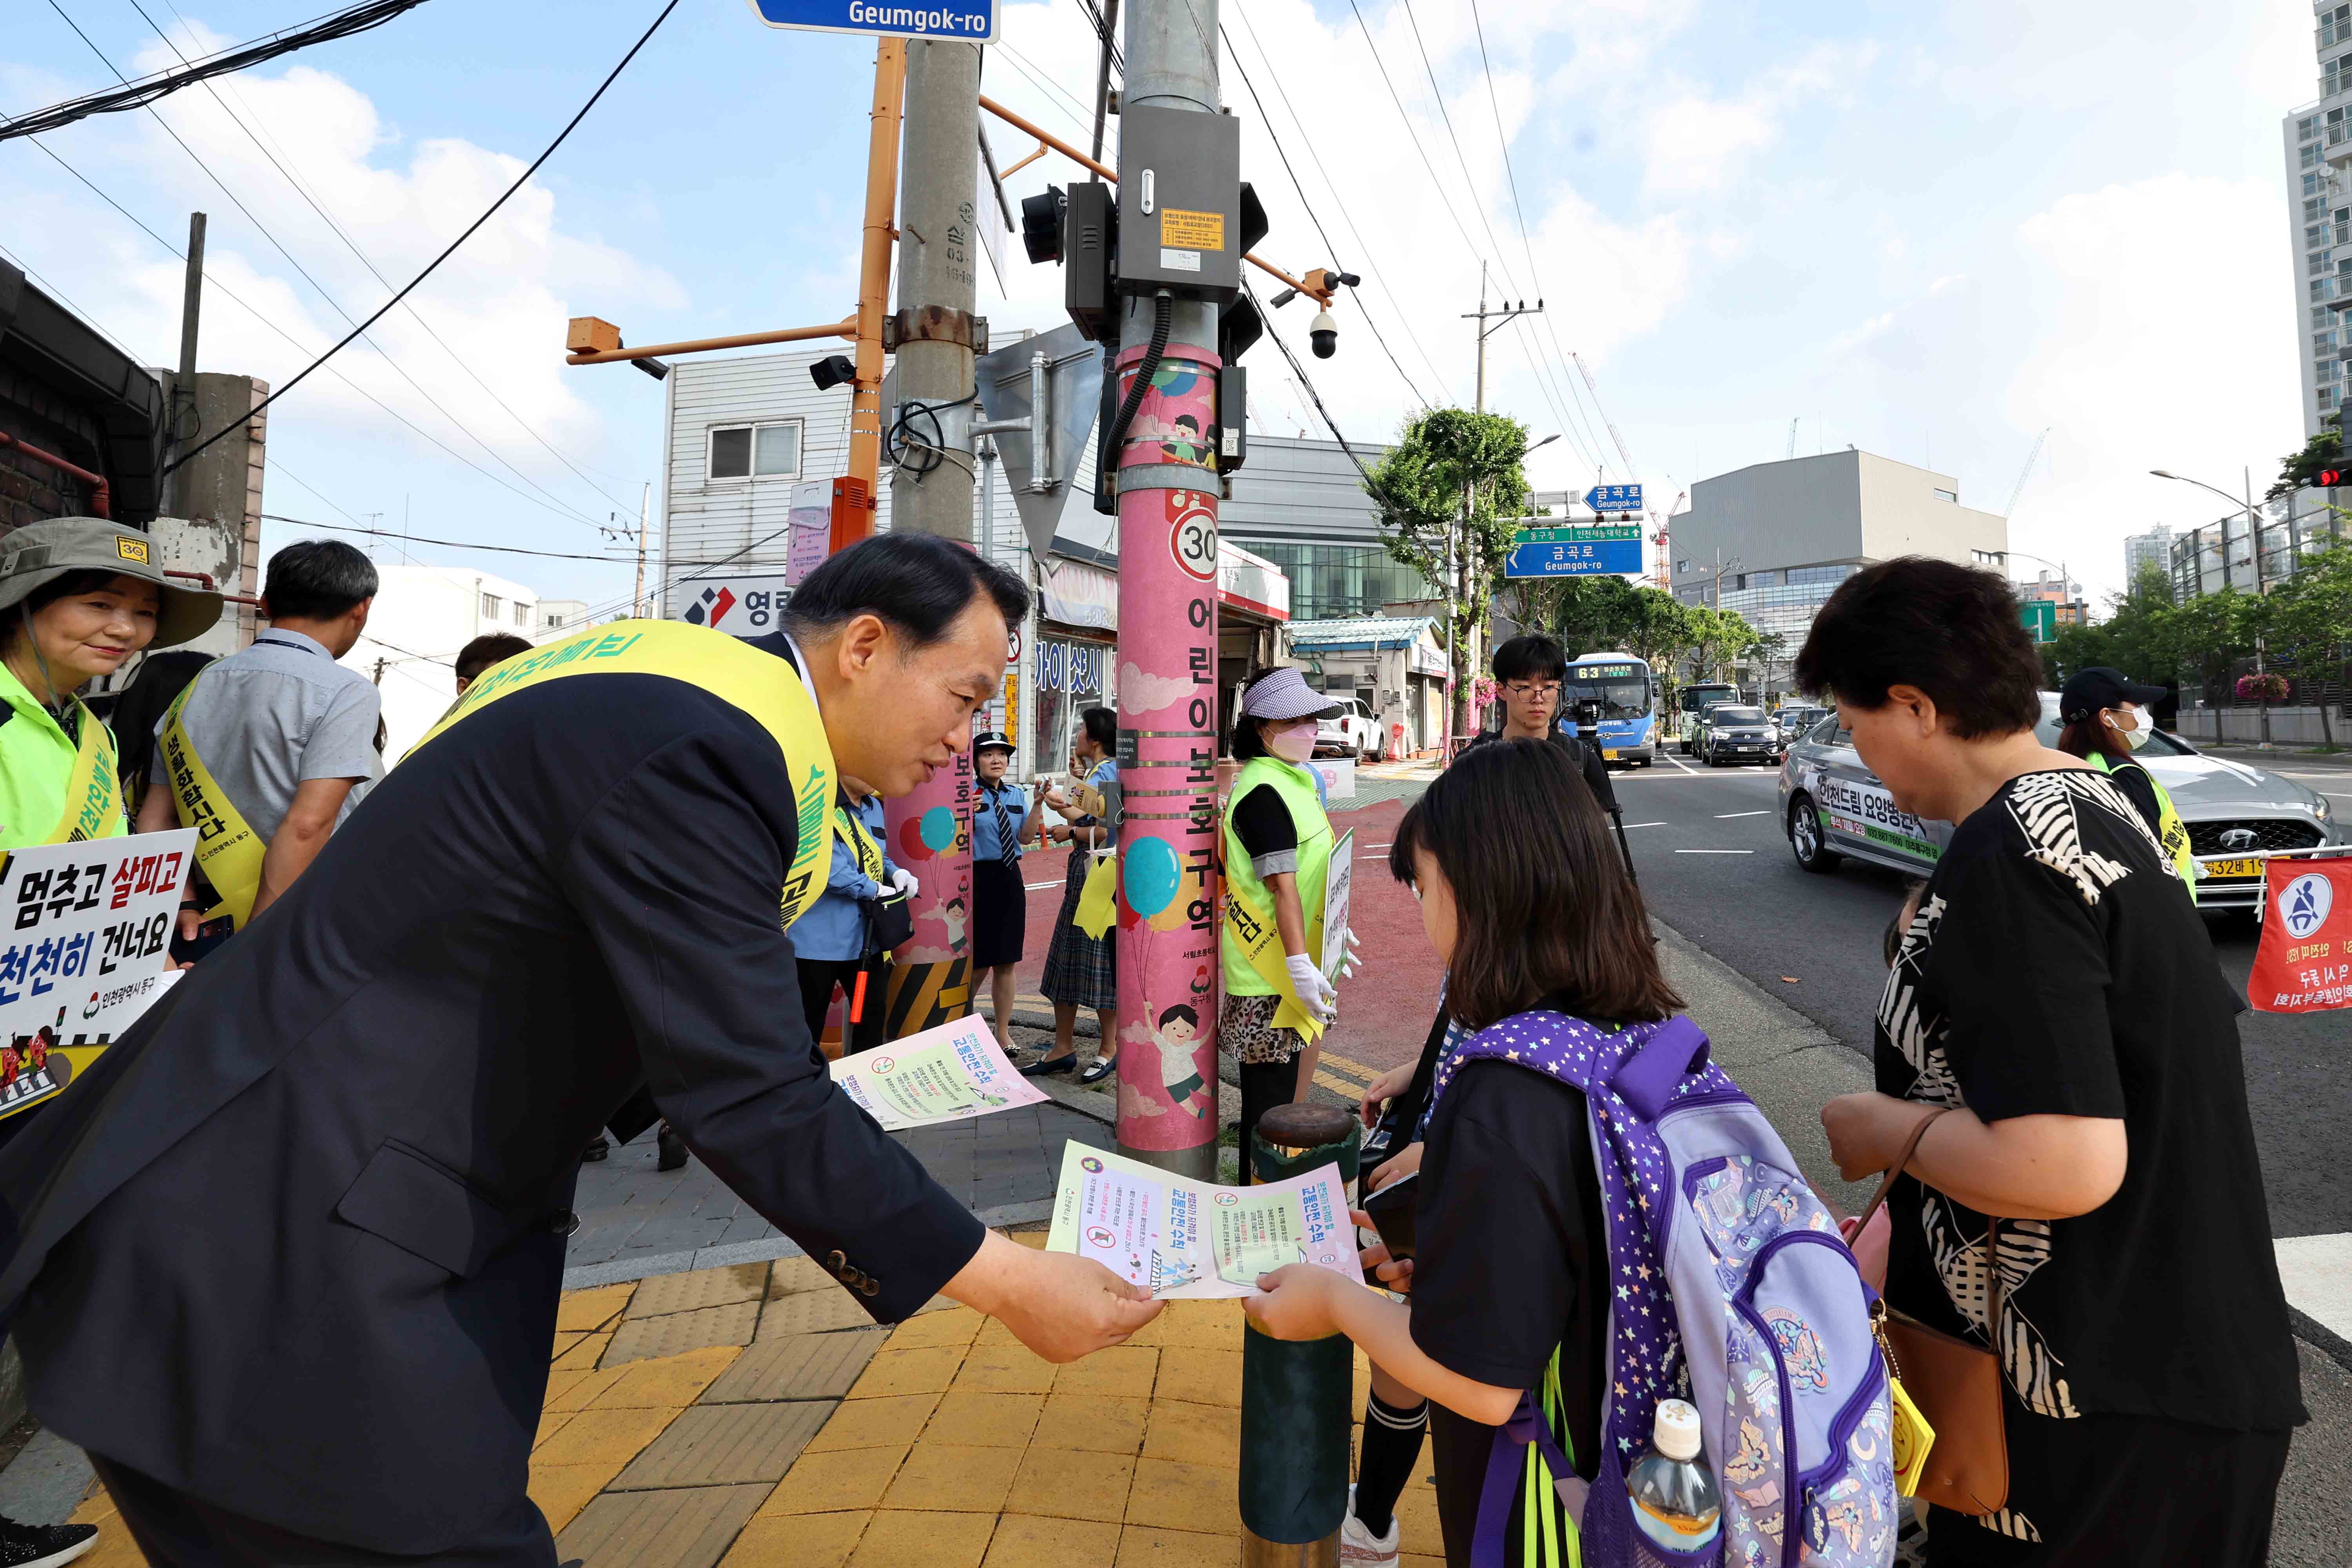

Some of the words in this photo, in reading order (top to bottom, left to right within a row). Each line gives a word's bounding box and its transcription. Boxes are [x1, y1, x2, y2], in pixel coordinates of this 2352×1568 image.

[850, 1, 985, 32] Geumgok-ro
[1597, 500, 1640, 509] Geumgok-ro
[1184, 526, 1215, 562] 30
[1530, 531, 1555, 541] 동구청
[1577, 528, 1630, 539] 인천재능대학교
[1545, 561, 1602, 571] Geumgok-ro
[1579, 667, 1599, 679] 63
[1186, 598, 1214, 936] 어린이보호구역
[167, 734, 226, 841] 생활화합시다
[1820, 783, 1862, 816] 인천드림
[955, 755, 970, 855] 보호구역
[236, 830, 250, 842] 동구
[15, 864, 107, 930] 멈추고
[110, 851, 183, 910] 살피고
[0, 931, 95, 1006] 천천히
[99, 912, 169, 976] 건너요
[102, 982, 141, 1009] 인천광역시
[141, 976, 155, 995] 동구
[1189, 994, 1211, 1007] 동구청
[953, 1036, 982, 1071] 교통안전
[973, 1069, 993, 1085] 수칙
[1170, 1188, 1186, 1225] 교통안전
[1302, 1185, 1321, 1223] 교통안전
[1170, 1229, 1186, 1250] 수칙
[1308, 1224, 1325, 1244] 수칙
